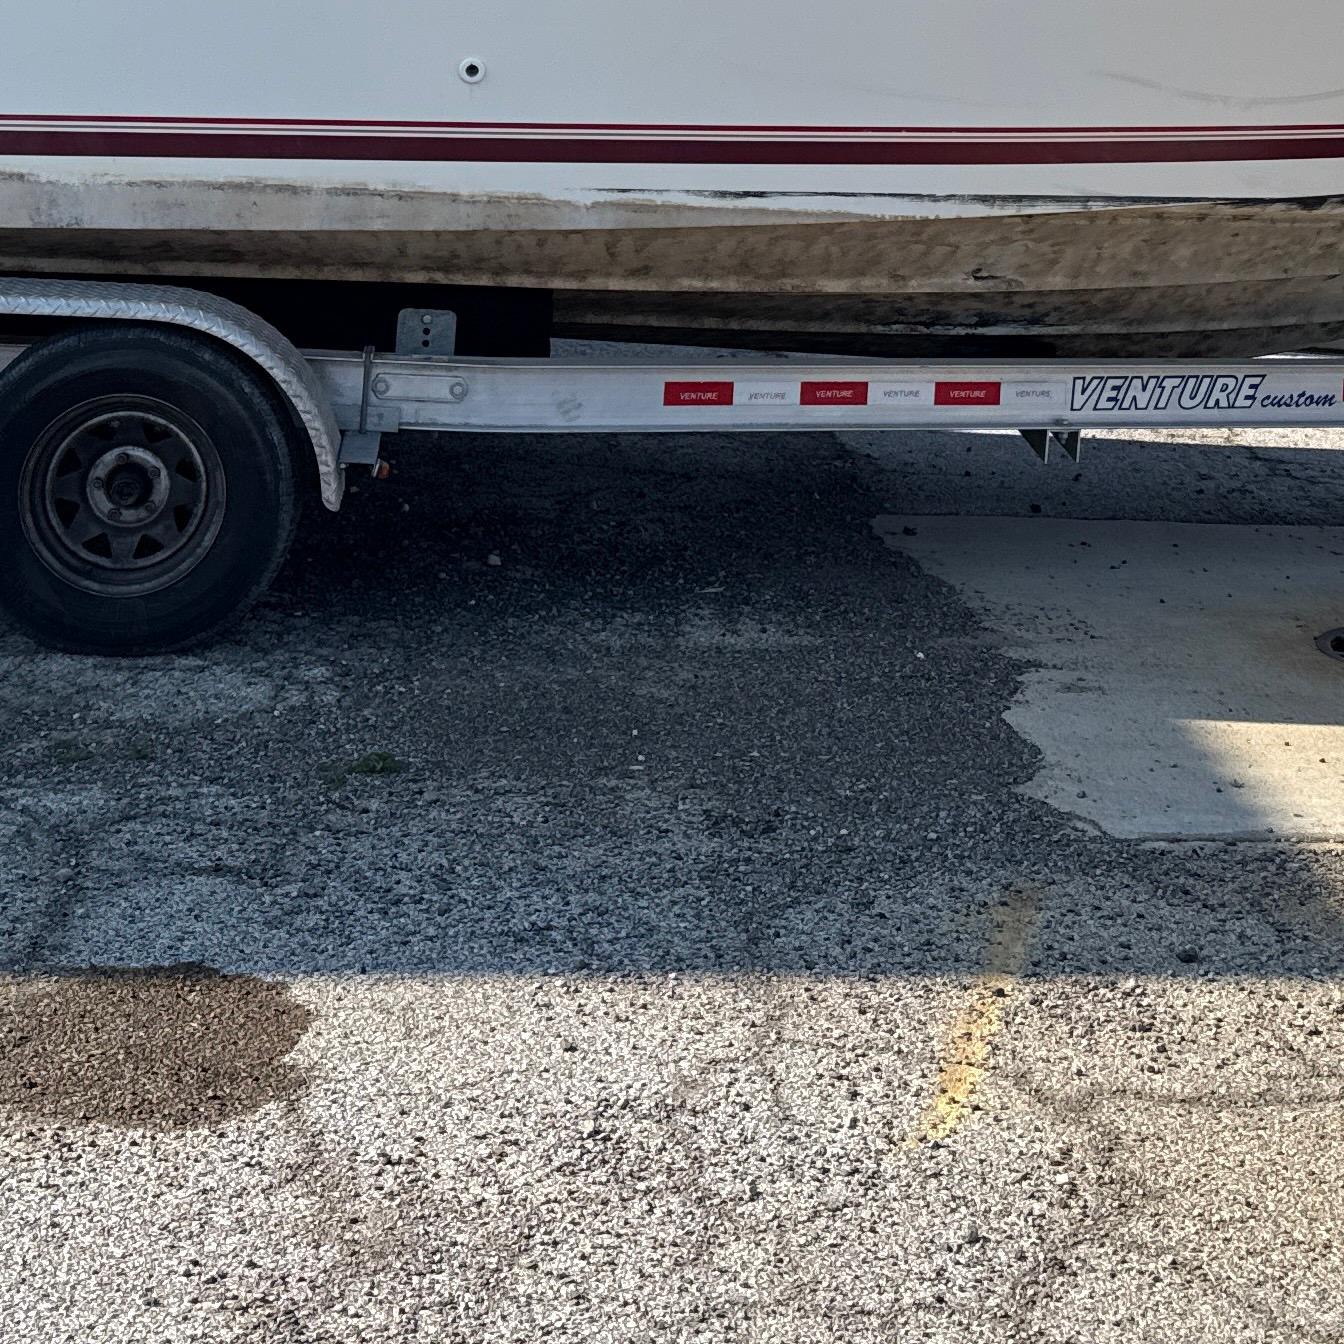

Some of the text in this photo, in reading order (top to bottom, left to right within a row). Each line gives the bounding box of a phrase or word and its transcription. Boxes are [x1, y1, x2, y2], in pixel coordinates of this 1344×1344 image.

[679, 392, 719, 400] VENTURE
[815, 390, 854, 398] VENTURE
[883, 390, 921, 398] VENTURE
[949, 390, 987, 398] VENTURE
[1070, 374, 1337, 412] VENTURE custom
